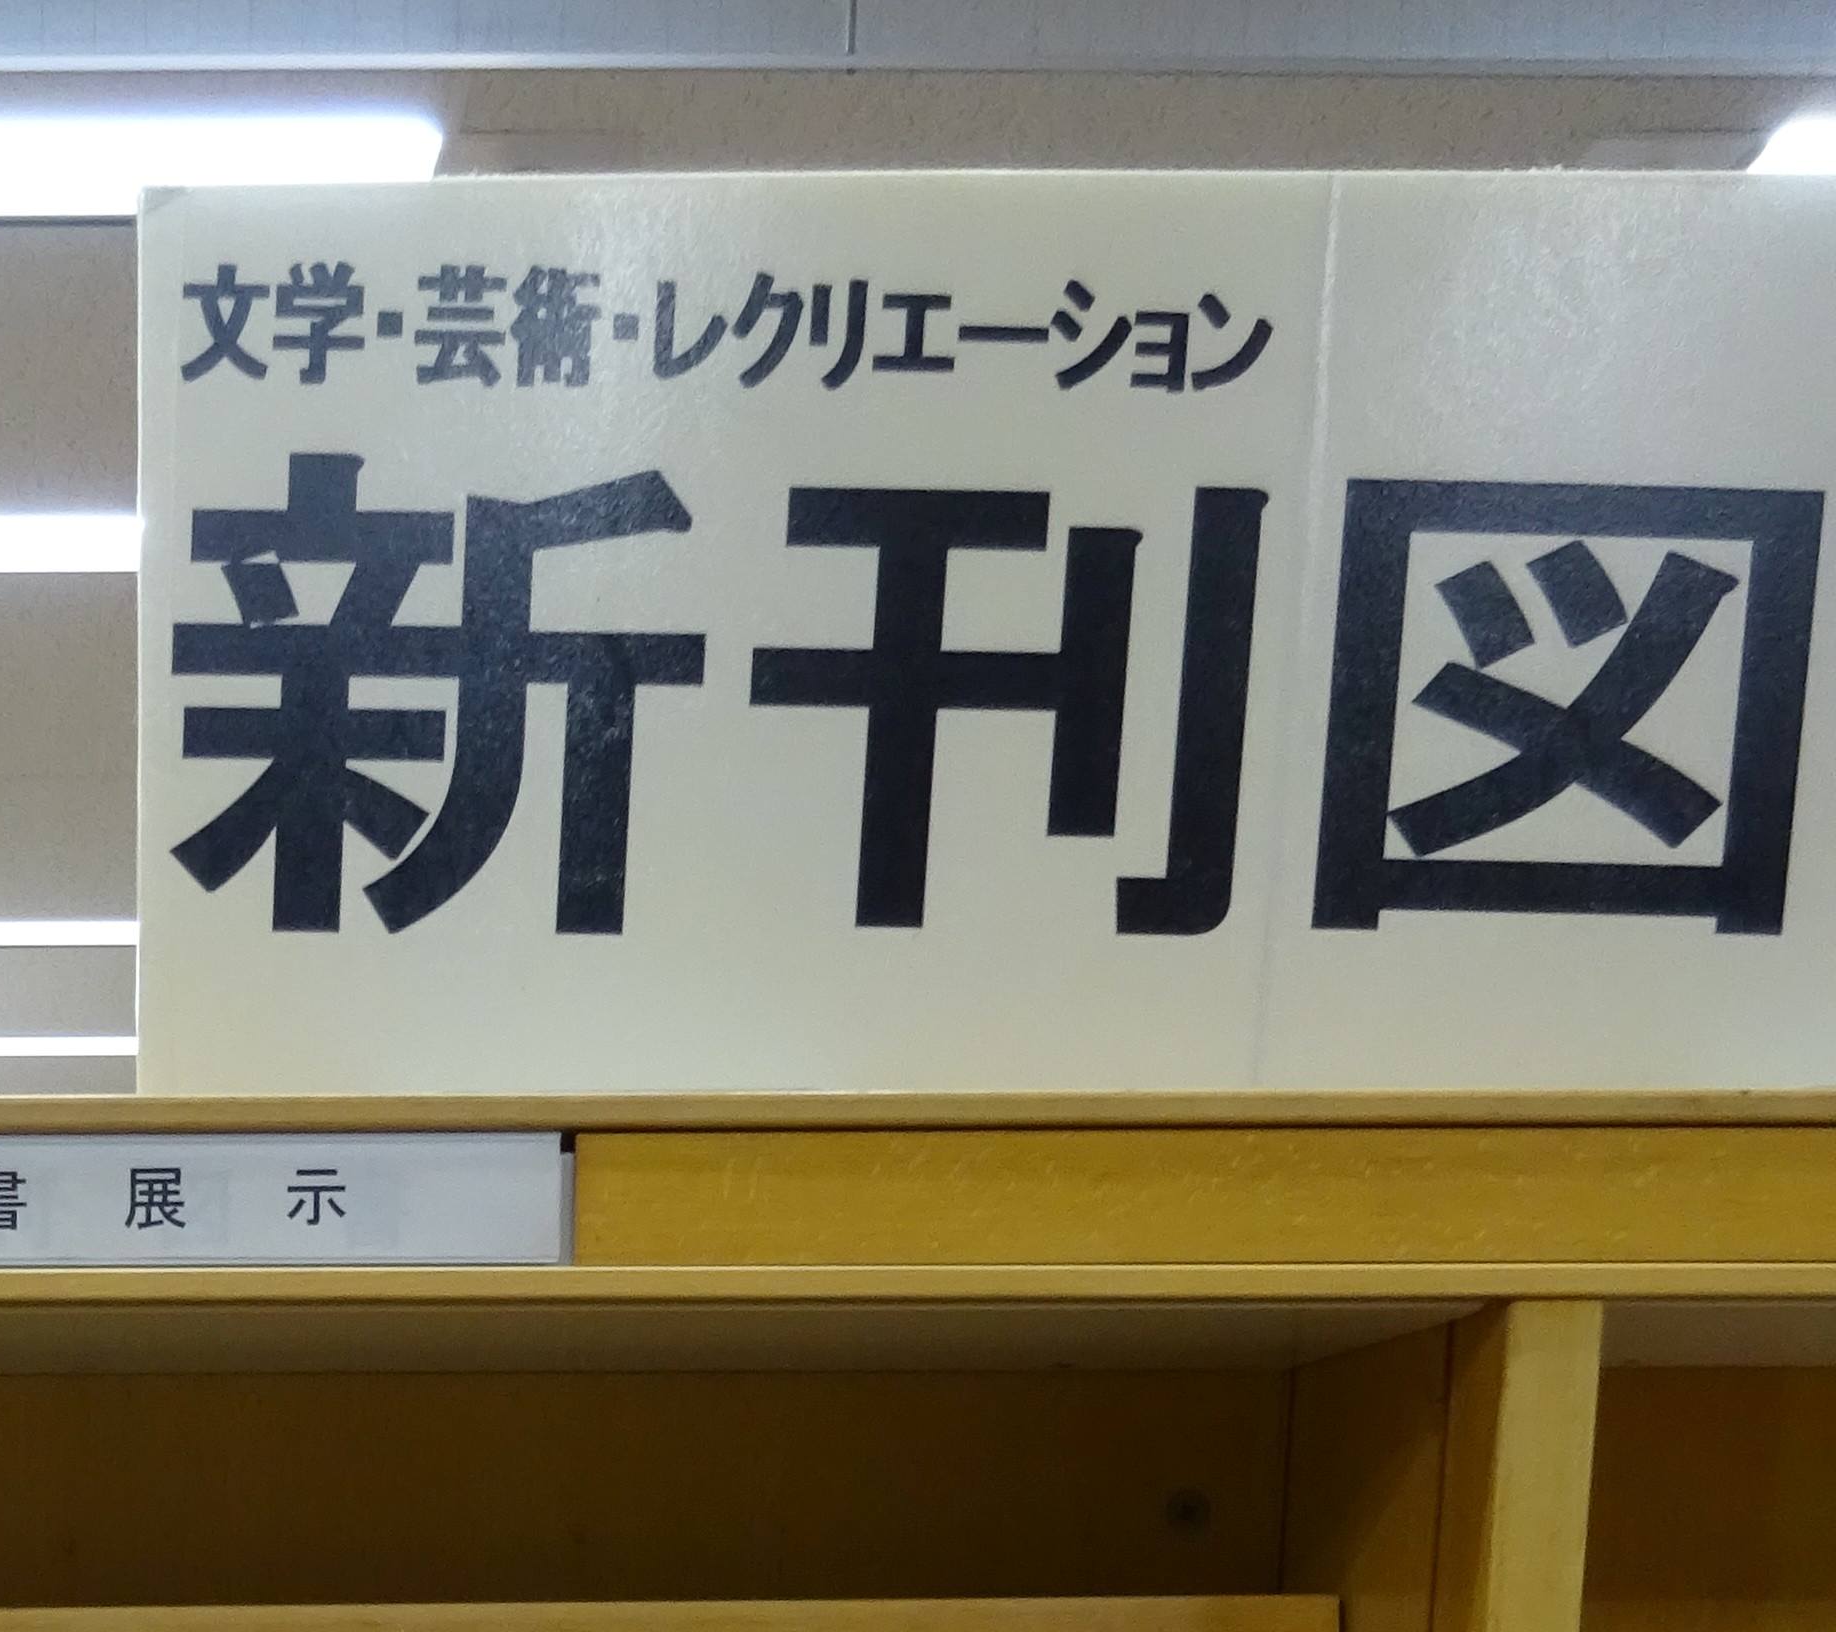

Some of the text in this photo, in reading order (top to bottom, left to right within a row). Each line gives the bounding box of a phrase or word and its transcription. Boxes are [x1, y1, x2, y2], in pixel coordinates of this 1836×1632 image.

[180, 263, 1273, 390] 文学・芸術・レクリエーション
[168, 453, 1826, 936] 新刊図
